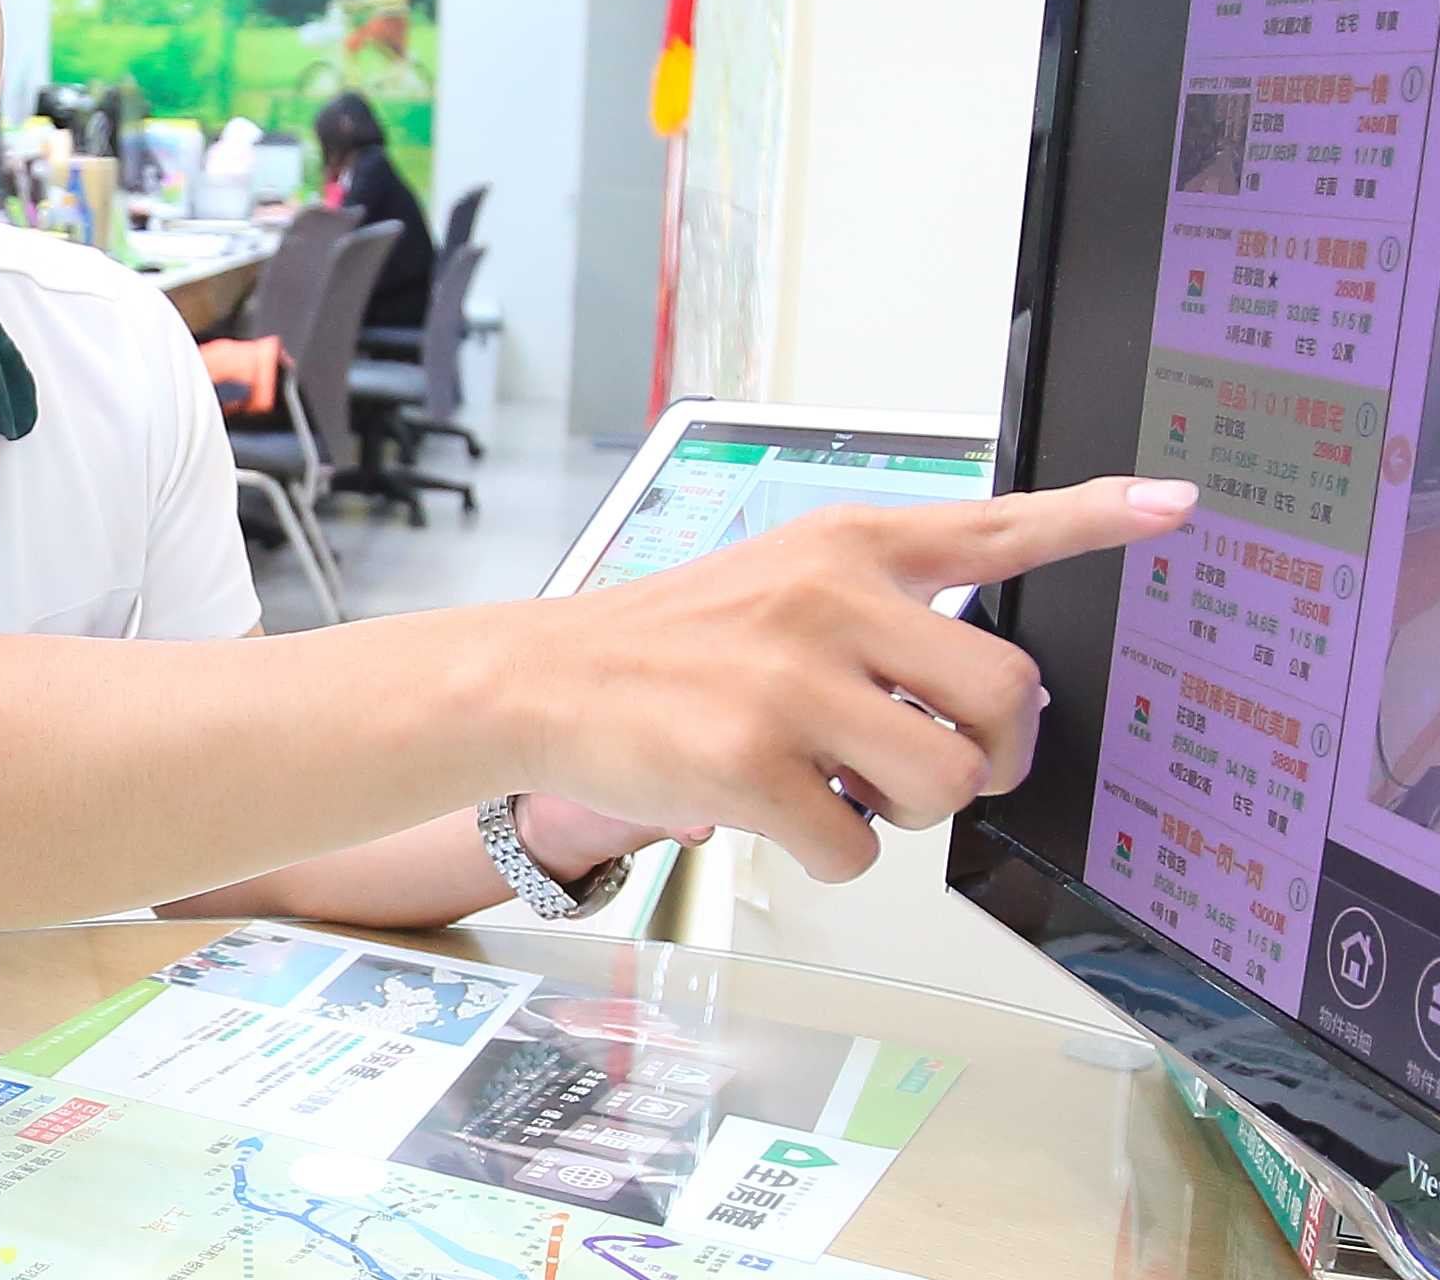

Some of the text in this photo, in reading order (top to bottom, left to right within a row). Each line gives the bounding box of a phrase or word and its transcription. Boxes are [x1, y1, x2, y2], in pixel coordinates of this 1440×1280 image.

[1335, 13, 1359, 32] 住宅
[1250, 113, 1286, 132] 莊敬路
[1313, 176, 1338, 196] 店面
[1232, 265, 1266, 287] 莊敬路
[1293, 335, 1317, 357] 住宅
[1330, 341, 1355, 364] 公寓
[1213, 414, 1246, 439] 莊敬路
[1273, 490, 1295, 514] 住宅
[1309, 500, 1333, 525] 公寓
[1194, 560, 1226, 588] 莊敬路
[1252, 641, 1275, 667] 店面
[1287, 655, 1310, 682] 公寓
[1176, 703, 1207, 734] 莊敬路
[1232, 790, 1254, 818] 住宅
[1156, 843, 1188, 877] 莊敬路
[1211, 935, 1233, 964] 店面
[1245, 956, 1267, 986] 公寓
[1318, 1004, 1373, 1056] 物件明細
[341, 1036, 418, 1085] 全房產
[288, 1072, 357, 1118] 三大優勢
[704, 1161, 804, 1232] 全房產
[137, 1201, 197, 1238] 土城
